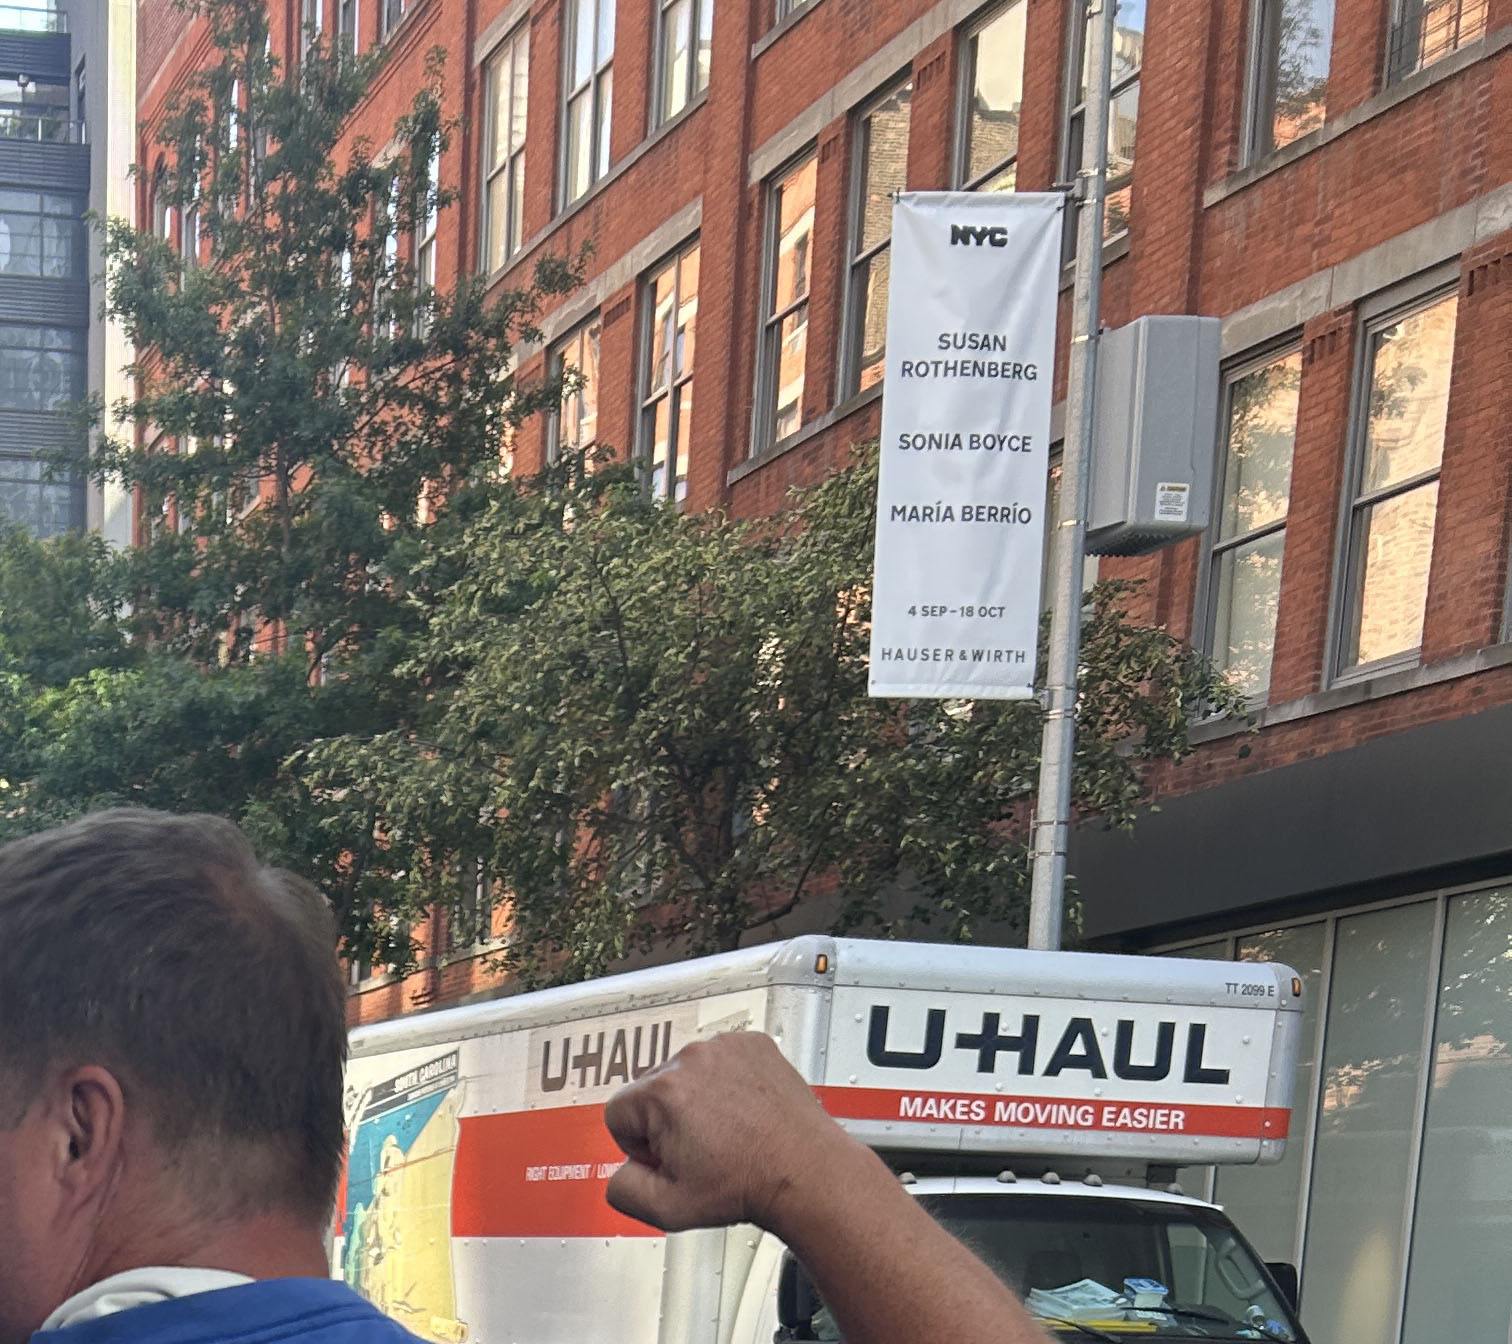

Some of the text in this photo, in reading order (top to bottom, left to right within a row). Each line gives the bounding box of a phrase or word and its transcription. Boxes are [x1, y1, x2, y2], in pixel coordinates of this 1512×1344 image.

[950, 223, 1008, 247] NYC
[937, 332, 1007, 352] SUSAN
[901, 360, 1038, 381] ROTHENBERG
[898, 433, 1033, 453] SONIA BOYCE
[890, 500, 1032, 525] MARÍA BERRÍO
[907, 605, 917, 617] 4
[978, 606, 1006, 618] OCT
[881, 647, 1026, 664] HAUSER & WIRTH
[1225, 982, 1276, 998] TT 2099 E
[866, 1004, 1231, 1085] U-HAUL
[899, 1095, 1186, 1131] MAKES MOVING EASIER
